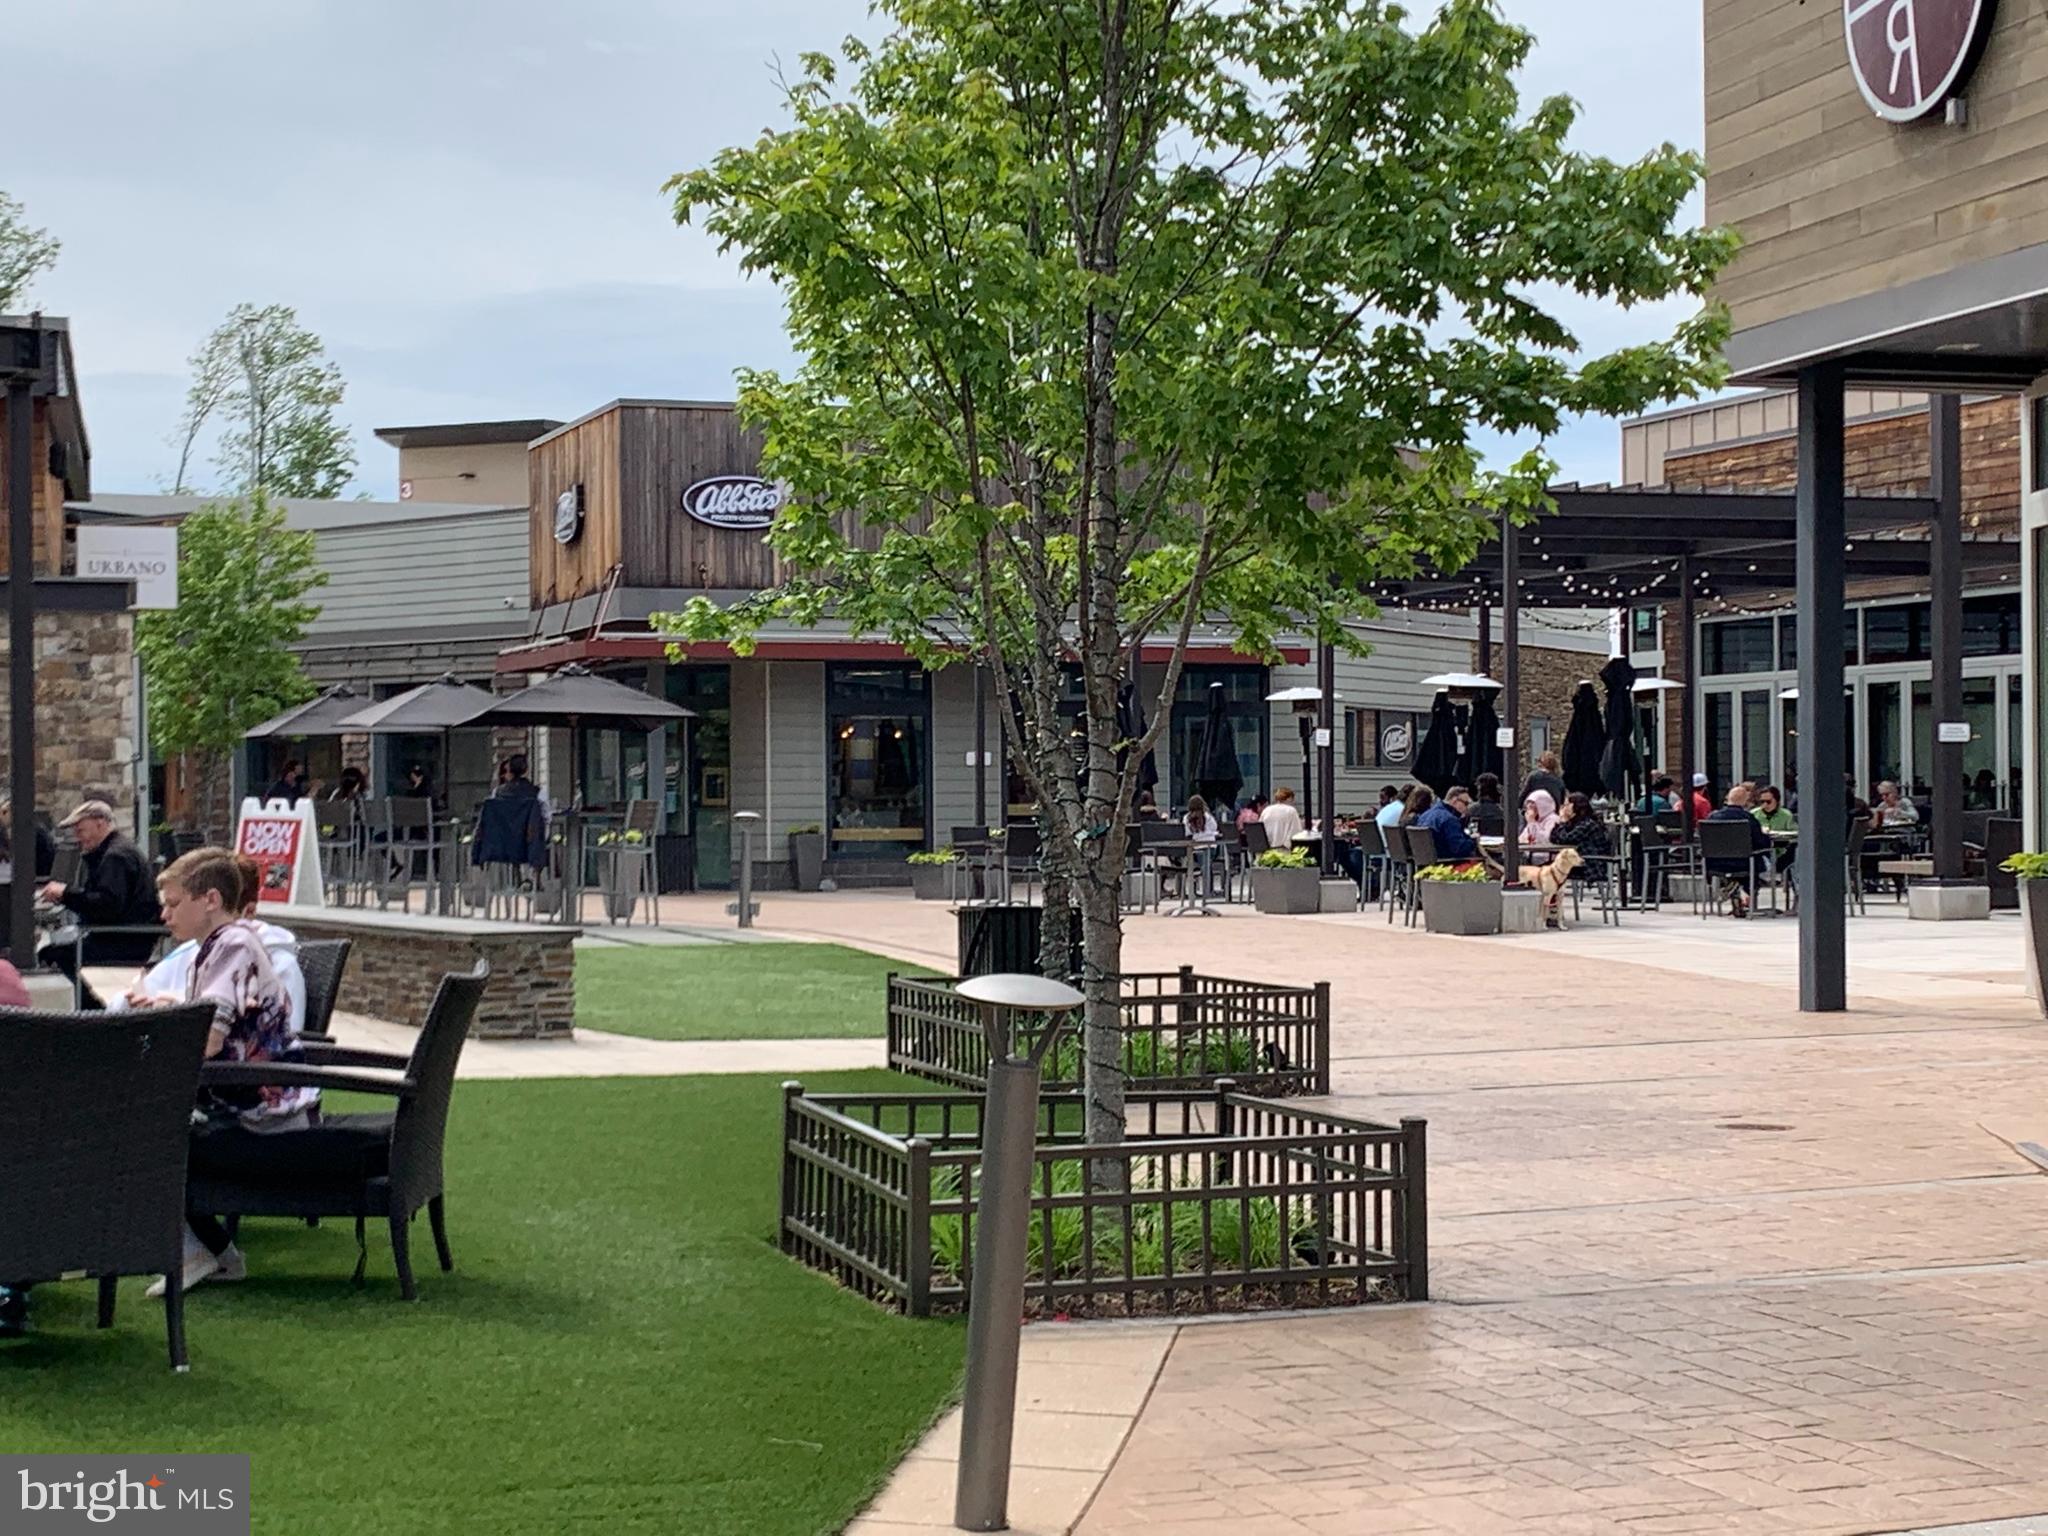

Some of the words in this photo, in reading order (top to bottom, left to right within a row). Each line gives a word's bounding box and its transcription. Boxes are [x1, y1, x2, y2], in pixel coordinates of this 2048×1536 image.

[88, 560, 167, 576] URBANO
[246, 822, 297, 839] NOW
[243, 838, 293, 855] OPEN
